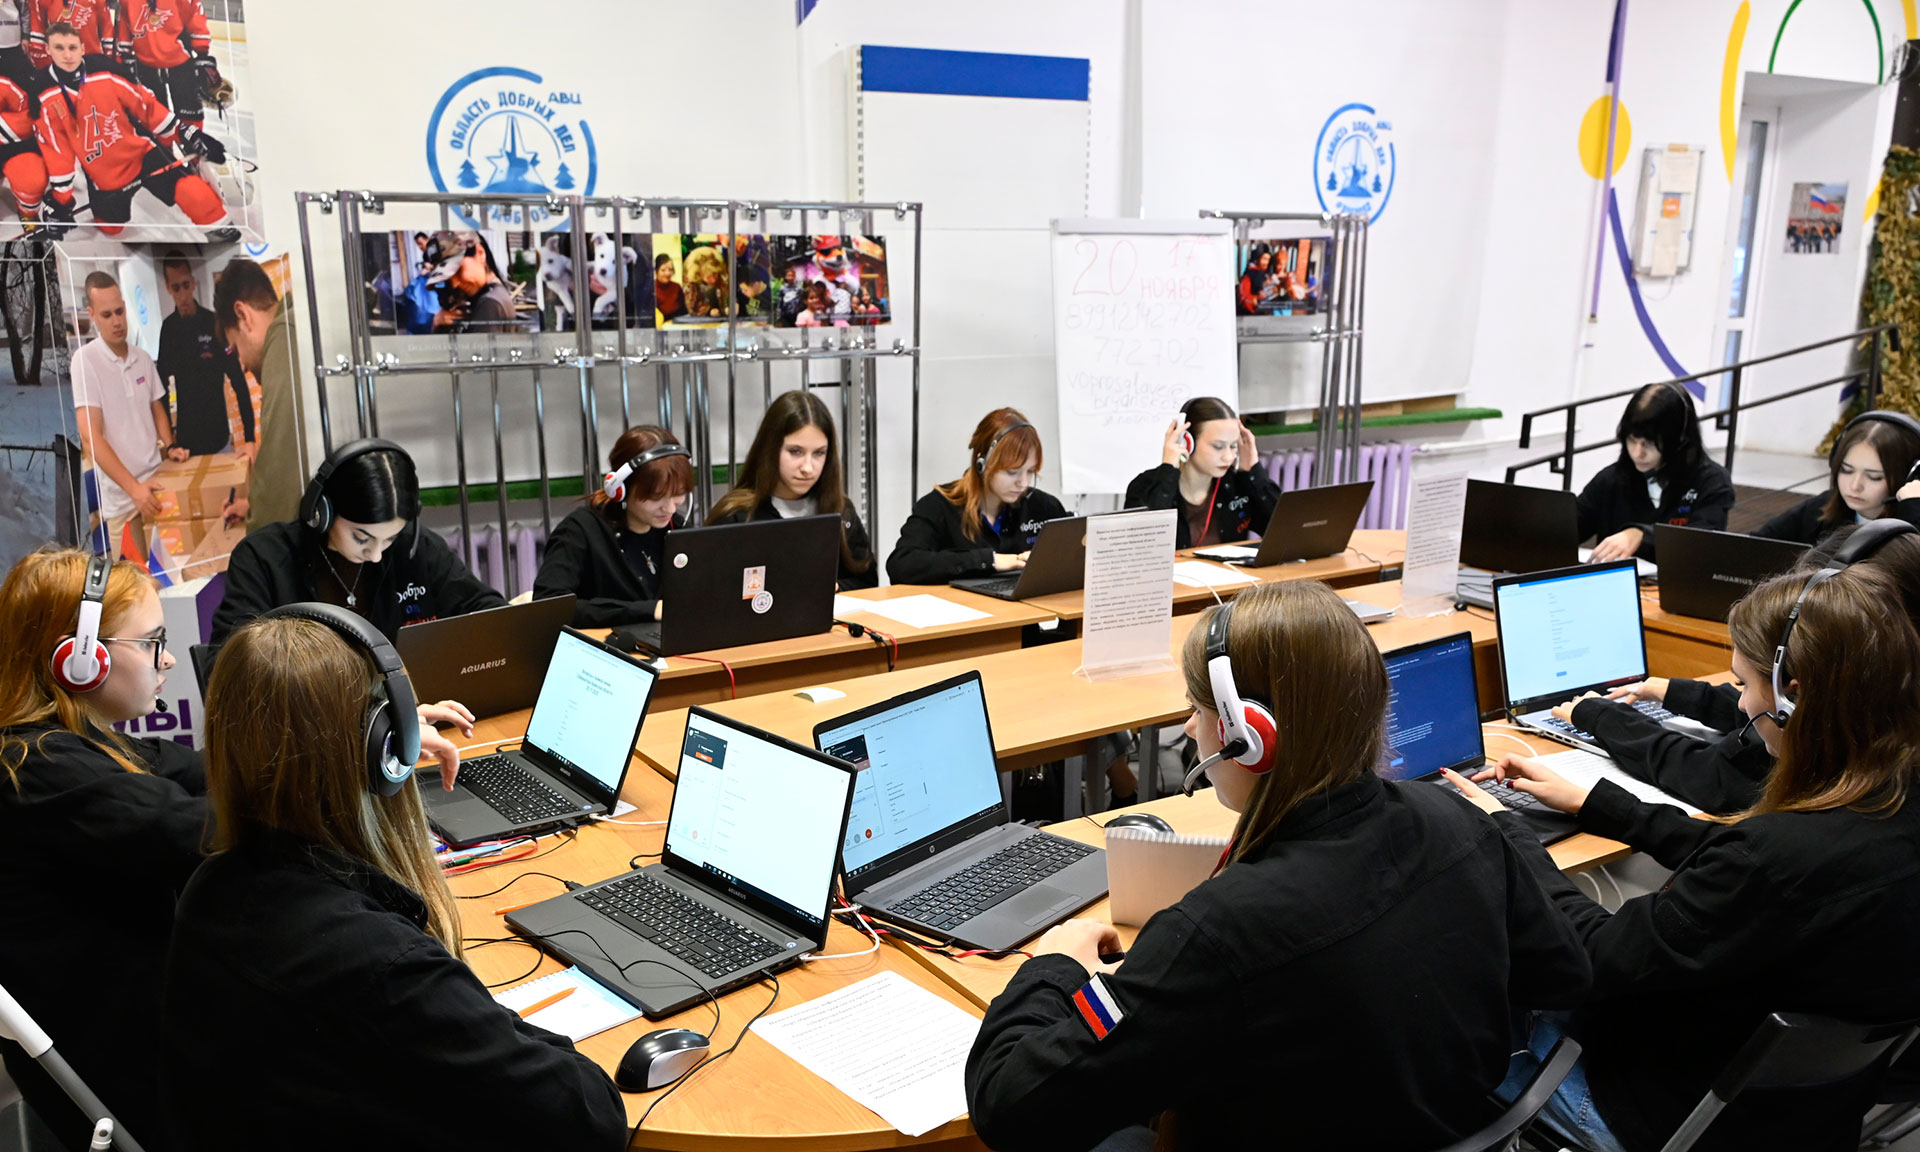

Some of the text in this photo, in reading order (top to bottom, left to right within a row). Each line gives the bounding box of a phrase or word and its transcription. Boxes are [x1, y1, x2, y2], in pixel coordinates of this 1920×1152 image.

[548, 92, 582, 104] АВЦ
[450, 91, 576, 153] ОБЛАСТЬ ДОБРЫХ ДЕЛ
[1071, 239, 1139, 297] 20
[1141, 275, 1220, 300] НОЯБРЯ
[1094, 335, 1206, 369] 772702
[1712, 573, 1754, 586] AQUARIUS
[460, 658, 507, 675] AQUARIUS
